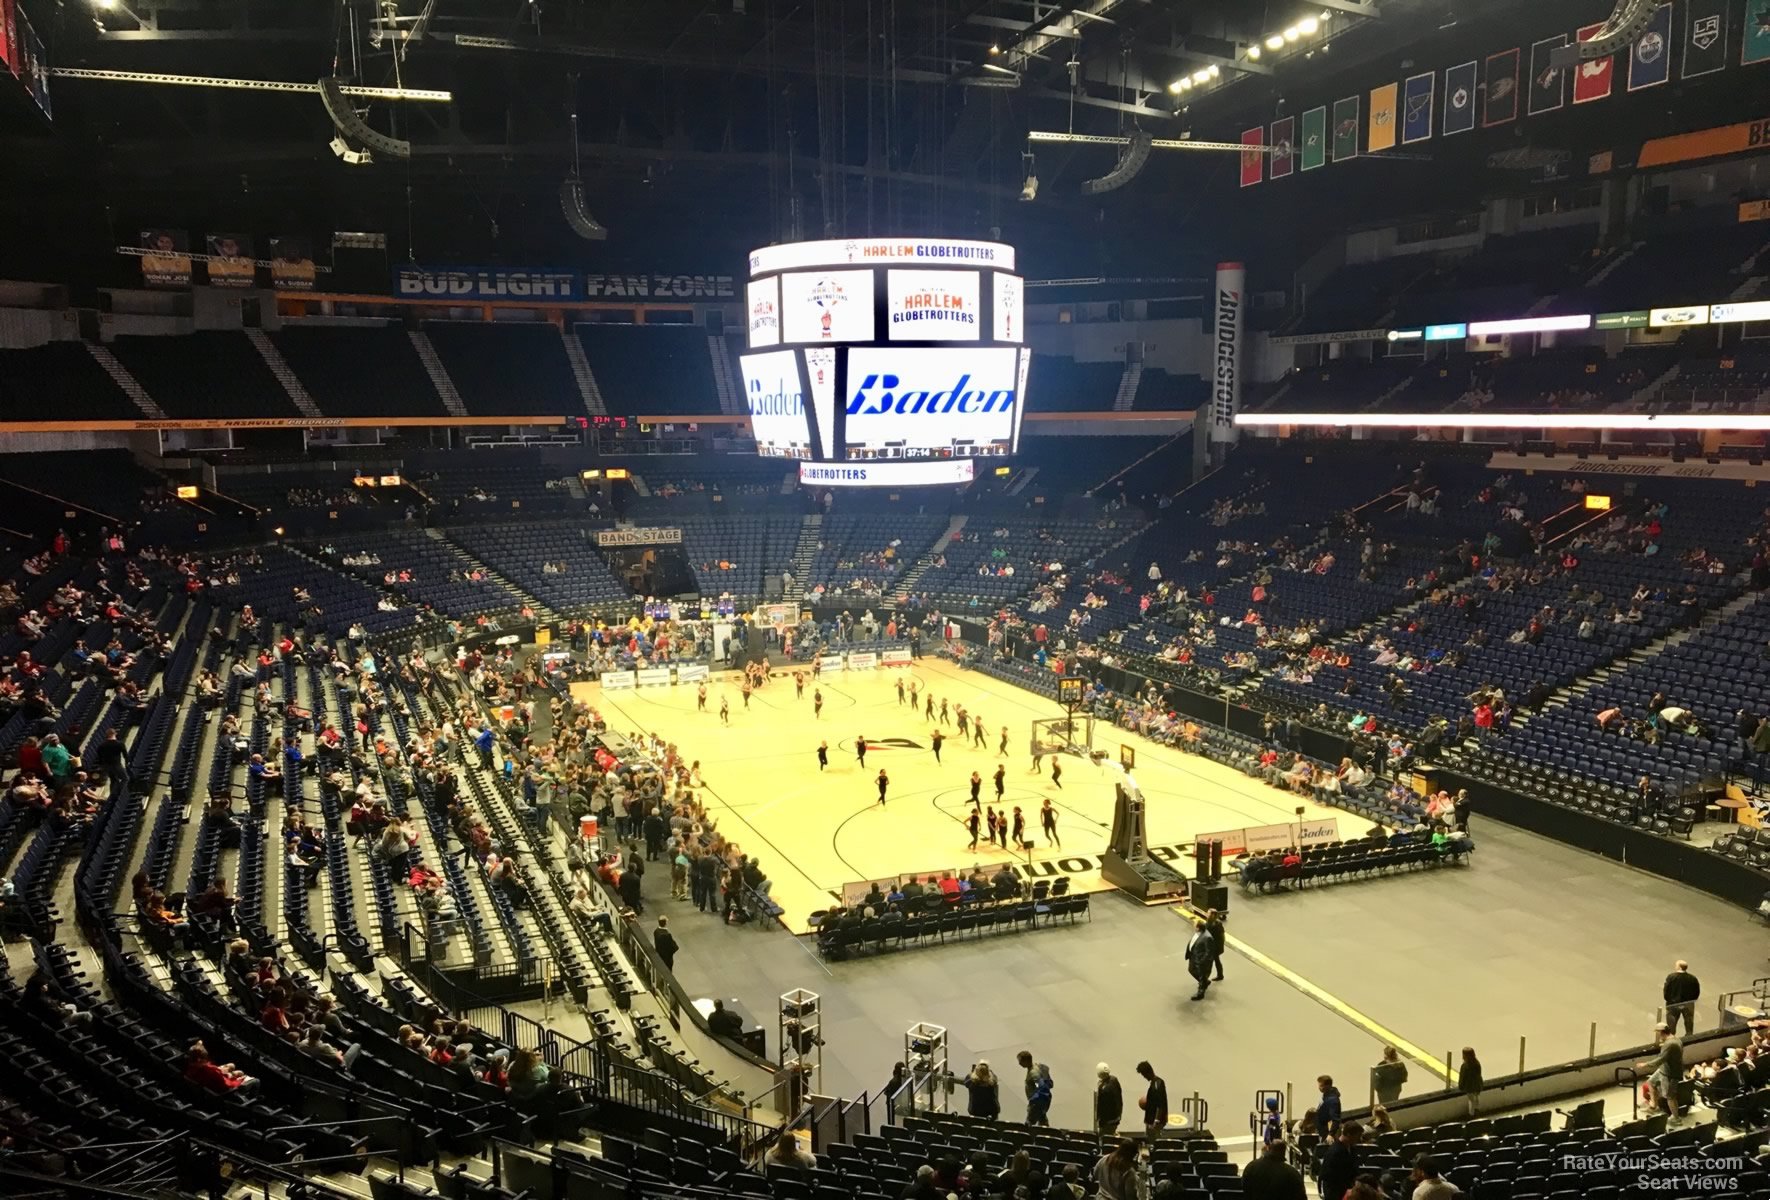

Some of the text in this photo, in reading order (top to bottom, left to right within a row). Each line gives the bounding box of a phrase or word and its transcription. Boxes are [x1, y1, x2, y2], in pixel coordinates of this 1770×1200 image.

[1695, 20, 1717, 33] LA
[864, 245, 994, 260] HARLEM GLOBETROTTERS
[400, 271, 574, 295] BUD LIGHT
[587, 274, 734, 297] FAN ZONE
[905, 294, 963, 310] HARLEM
[893, 310, 974, 323] GLOBETROTTERS
[1216, 288, 1239, 429] BRIDGESTONE
[751, 378, 804, 416] Baden
[846, 374, 1014, 415] Baden
[907, 448, 931, 457] 37:14
[804, 468, 867, 480] GLOBETROTTERS
[1567, 461, 1715, 478] BRIDGESTONE ARENA
[601, 530, 679, 542] BAND STAGE
[1298, 825, 1334, 839] Baden
